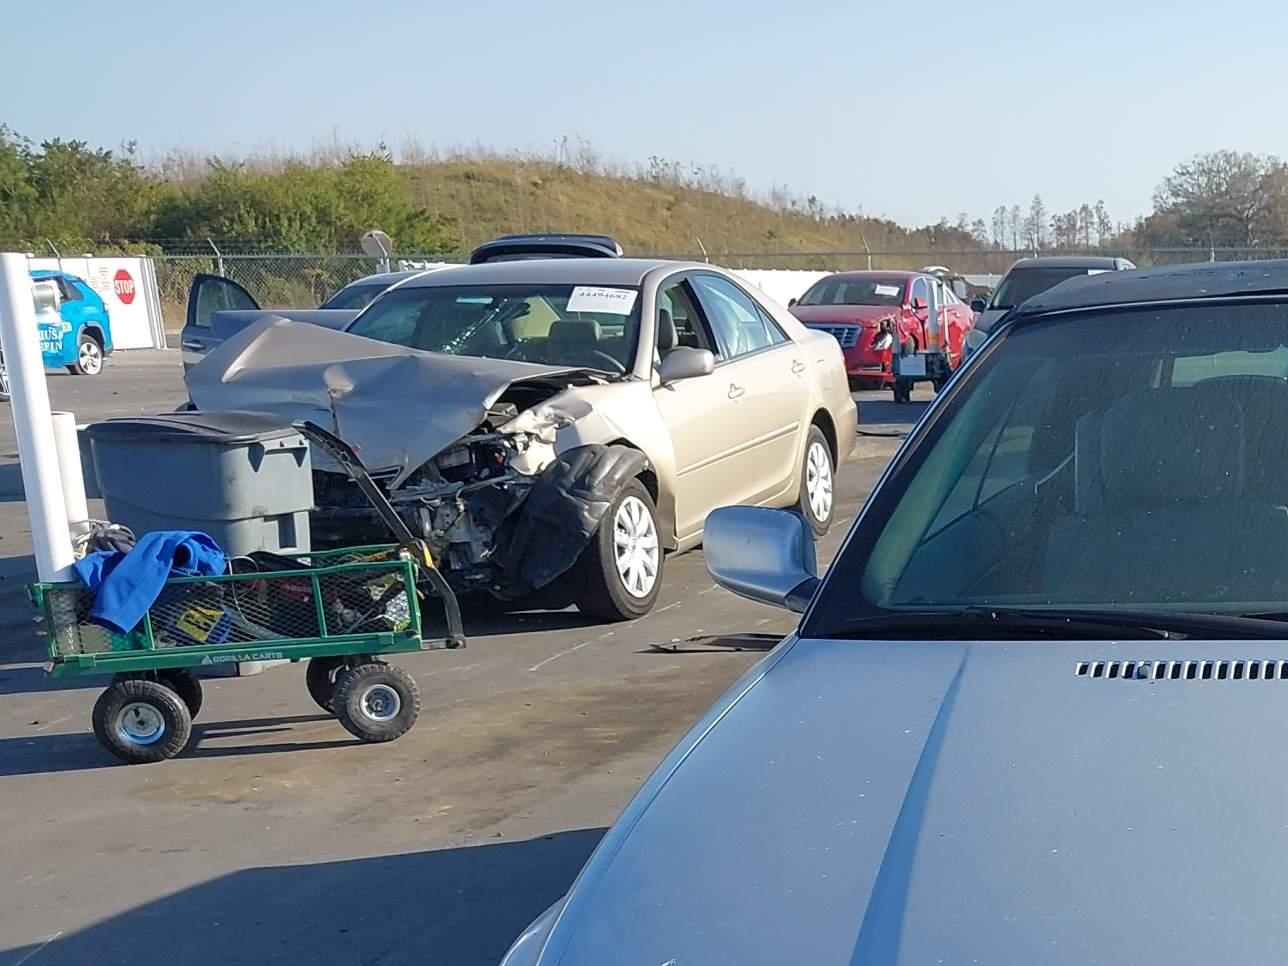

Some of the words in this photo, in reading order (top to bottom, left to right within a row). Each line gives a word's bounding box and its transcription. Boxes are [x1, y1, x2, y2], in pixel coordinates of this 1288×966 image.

[115, 279, 134, 294] STOP
[213, 654, 251, 663] GORILLA
[253, 652, 283, 660] CARTS
